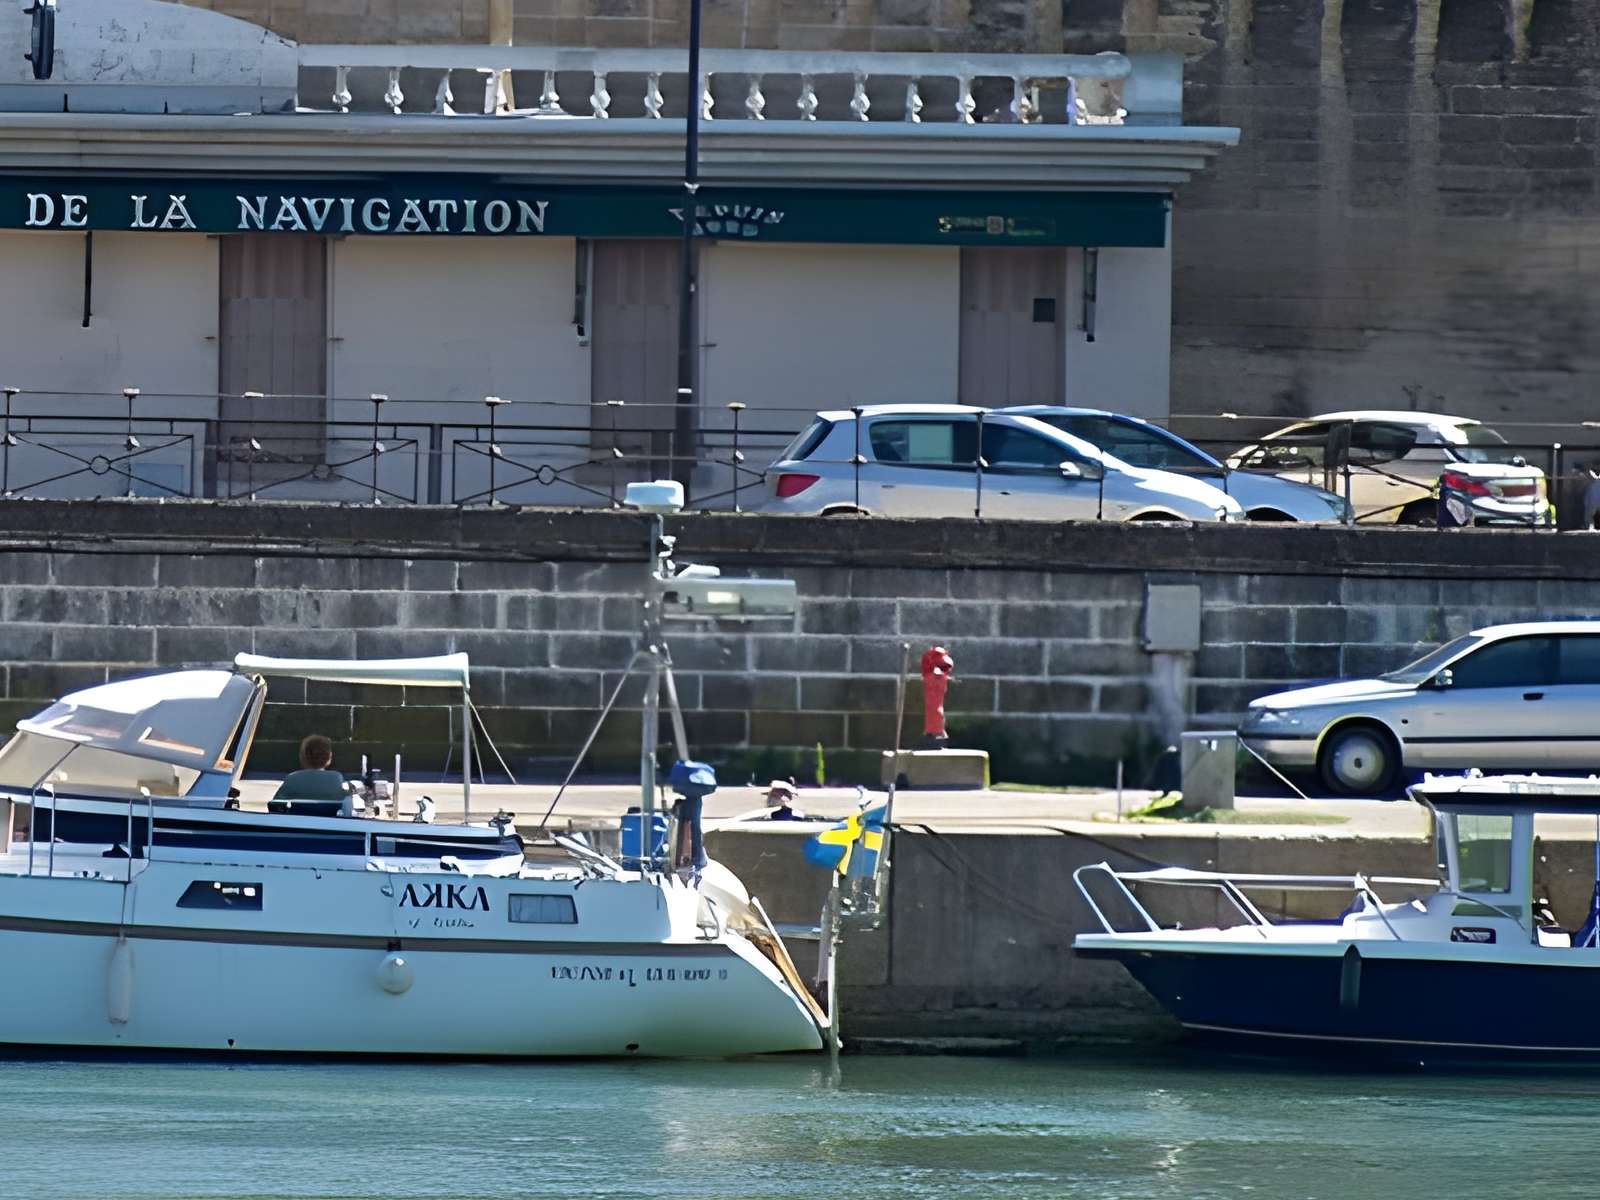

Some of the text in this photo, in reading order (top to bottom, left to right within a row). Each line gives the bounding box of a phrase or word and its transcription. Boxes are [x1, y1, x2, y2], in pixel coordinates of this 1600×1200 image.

[25, 192, 89, 227] DE
[130, 194, 197, 229] LA
[236, 195, 550, 234] NAVIGATION
